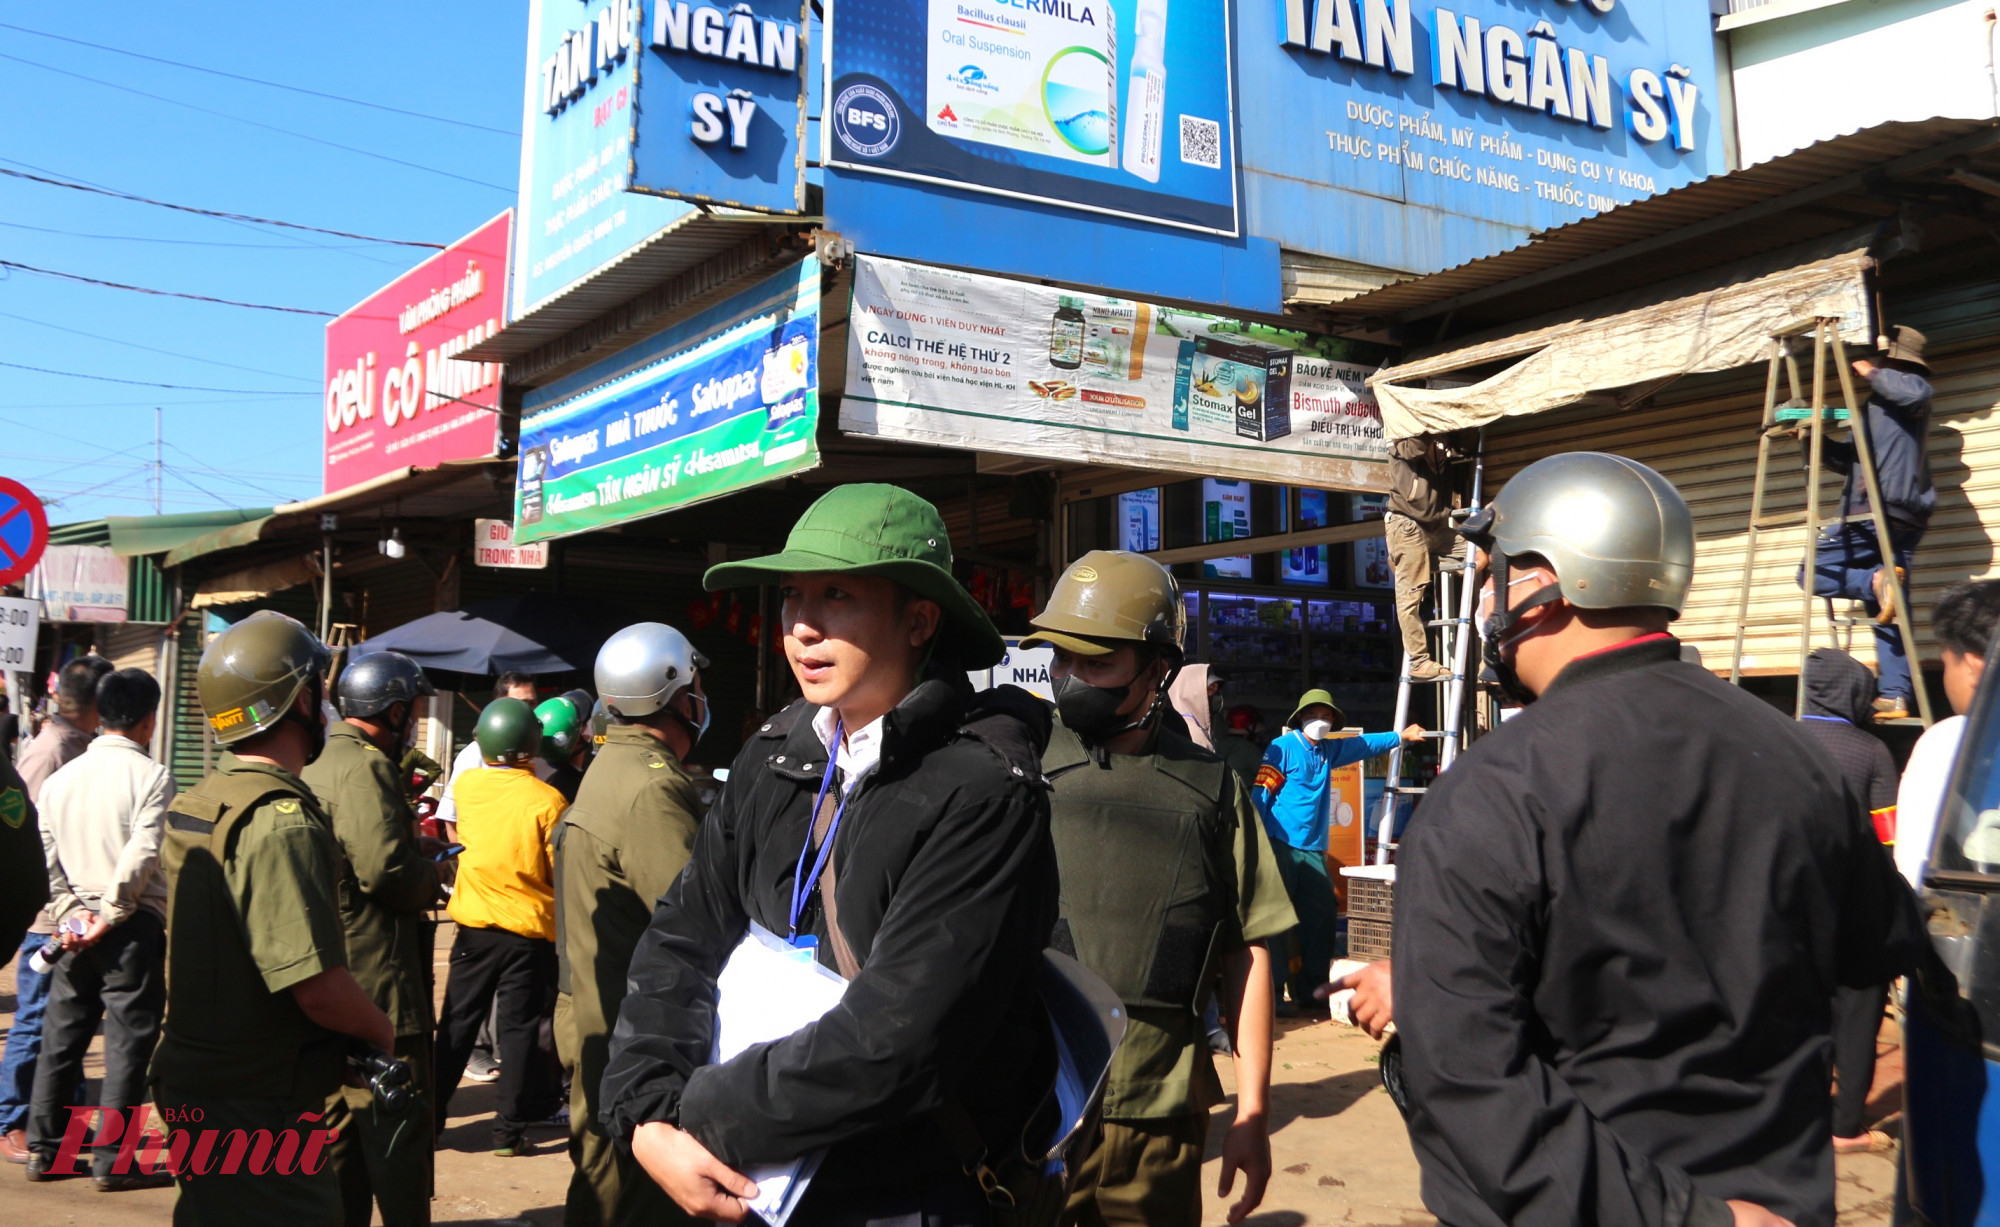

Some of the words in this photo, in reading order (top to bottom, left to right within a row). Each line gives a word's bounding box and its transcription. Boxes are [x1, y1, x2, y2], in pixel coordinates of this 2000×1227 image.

[957, 4, 994, 22] Bacillus
[996, 16, 1026, 29] clausii
[649, 1, 796, 72] NGÂN
[942, 29, 965, 46] Oral
[968, 35, 1031, 61] Suspension
[1432, 7, 1613, 130] NGÂN
[1624, 62, 1698, 151] SỸ
[690, 88, 756, 148] SỸ
[848, 107, 886, 131] BFS
[1346, 100, 1394, 130] DƯỢC
[1399, 112, 1447, 146] PHẨM,
[1451, 126, 1474, 149] MỸ
[1480, 131, 1523, 161] PHẨM
[1537, 149, 1577, 174] DỤNG
[1580, 160, 1600, 184] CỤ
[1605, 166, 1614, 184] Y
[1618, 170, 1656, 193] KHOA
[1325, 131, 1371, 160] THỰC
[1378, 140, 1424, 171] PHẨM
[1428, 155, 1472, 183] CHỨC
[1476, 165, 1520, 193] NĂNG
[1534, 181, 1584, 208] THUỐC
[930, 317, 934, 325] 1
[959, 320, 979, 332] DUY
[864, 347, 896, 361] không
[922, 357, 948, 369] trong,
[950, 361, 978, 374] không
[867, 330, 911, 350] CALCI
[915, 338, 947, 355] THẾ
[948, 341, 969, 361] HỆ
[970, 347, 1001, 363] THỨ
[1002, 353, 1011, 365] 2
[1269, 357, 1288, 367] STOMAX
[1269, 367, 1277, 376] GEL
[1297, 359, 1317, 377] BẢO
[1321, 365, 1333, 379] VỆ
[1336, 367, 1360, 382] NIÊM
[326, 351, 375, 434] deli
[877, 377, 894, 386] nam
[1193, 394, 1233, 414] Stomax
[1238, 406, 1256, 420] Gel
[1294, 392, 1341, 415] Bismuth
[606, 412, 631, 447] NHÀ
[634, 391, 678, 437] THUỐC
[1311, 417, 1332, 434] ĐIỀU
[1335, 423, 1350, 438] TRỊ
[1352, 425, 1361, 437] VI
[597, 474, 622, 506] TÂN
[623, 464, 661, 499] NGÂN
[661, 454, 682, 489] SỸ
[479, 548, 515, 564] TRONG
[1013, 664, 1050, 683] NHÀ
